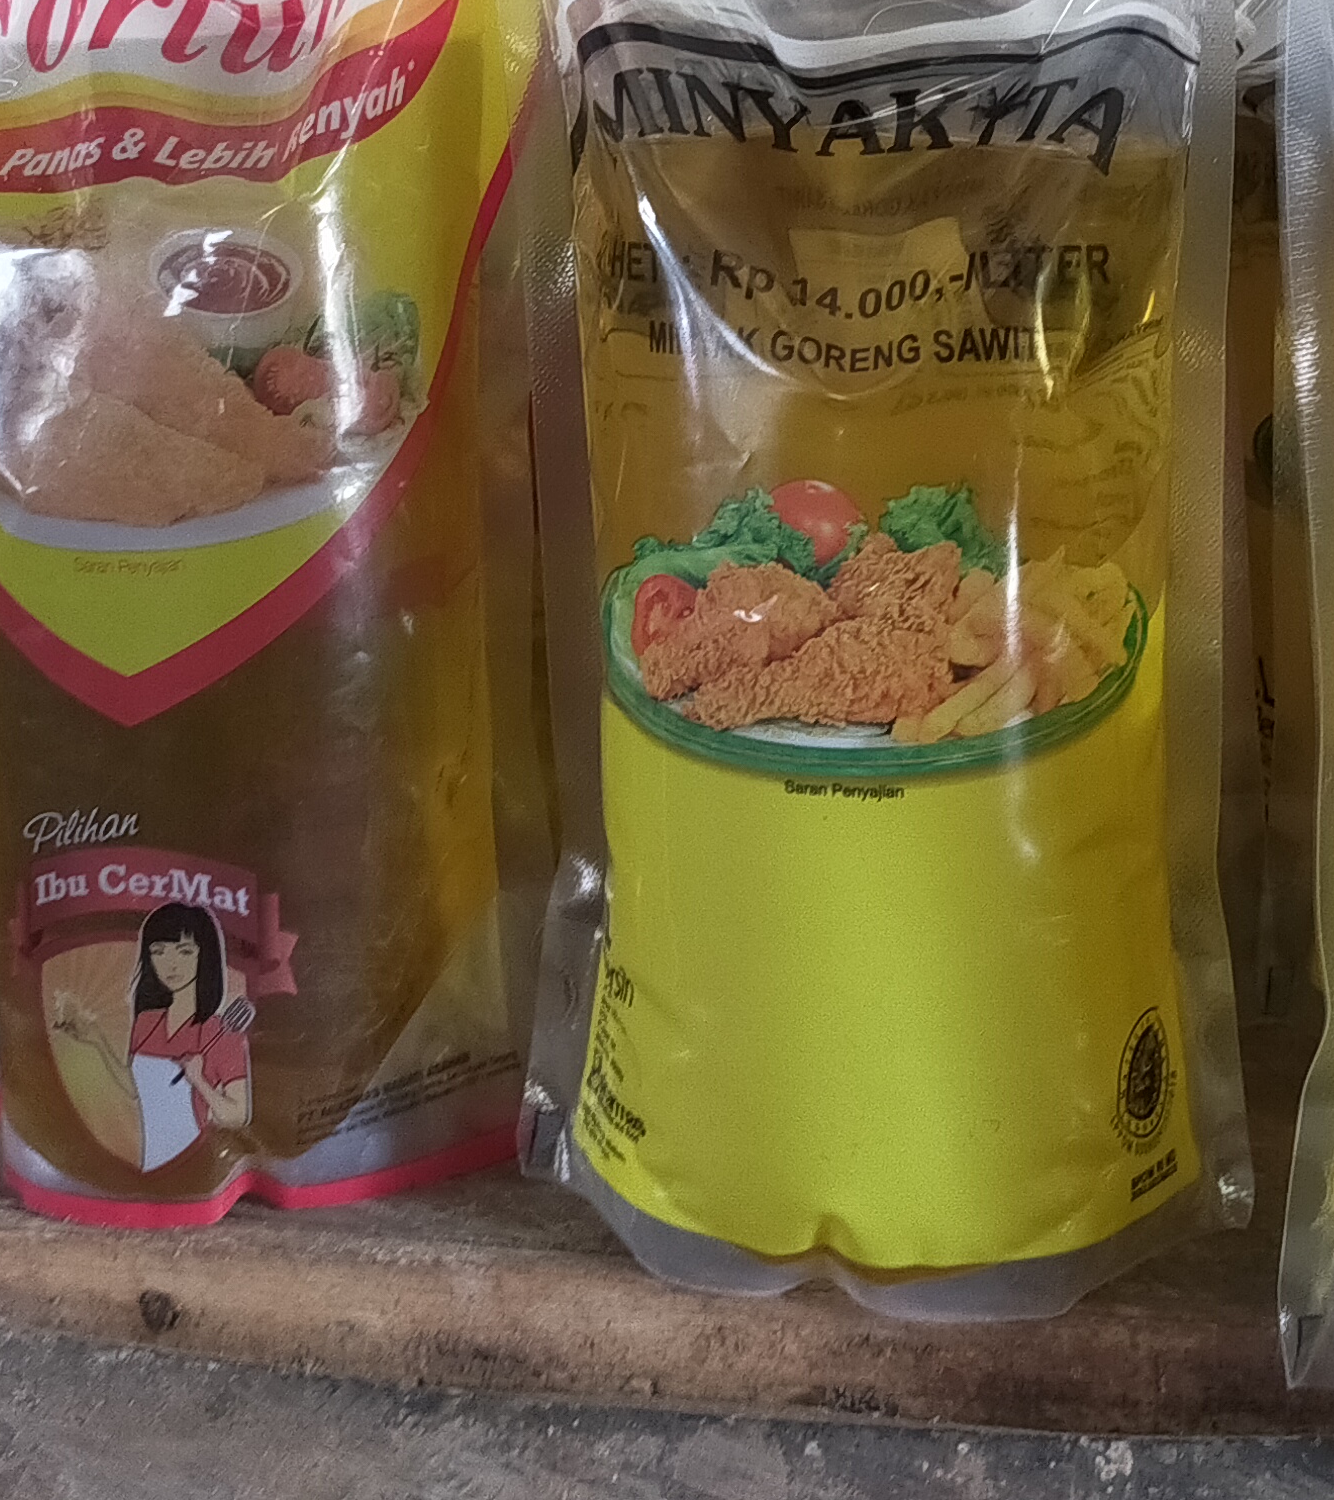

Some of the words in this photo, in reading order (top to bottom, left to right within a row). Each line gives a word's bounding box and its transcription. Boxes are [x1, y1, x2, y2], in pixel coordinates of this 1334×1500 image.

[111, 127, 147, 162] &
[154, 134, 278, 173] Lebih
[710, 249, 775, 301] Rp
[770, 328, 922, 373] GORENG
[783, 778, 827, 797] Saran
[831, 782, 906, 802] Penyajian
[22, 805, 140, 854] Pilihan
[34, 870, 88, 906] Ibu
[96, 863, 251, 917] CerMat
